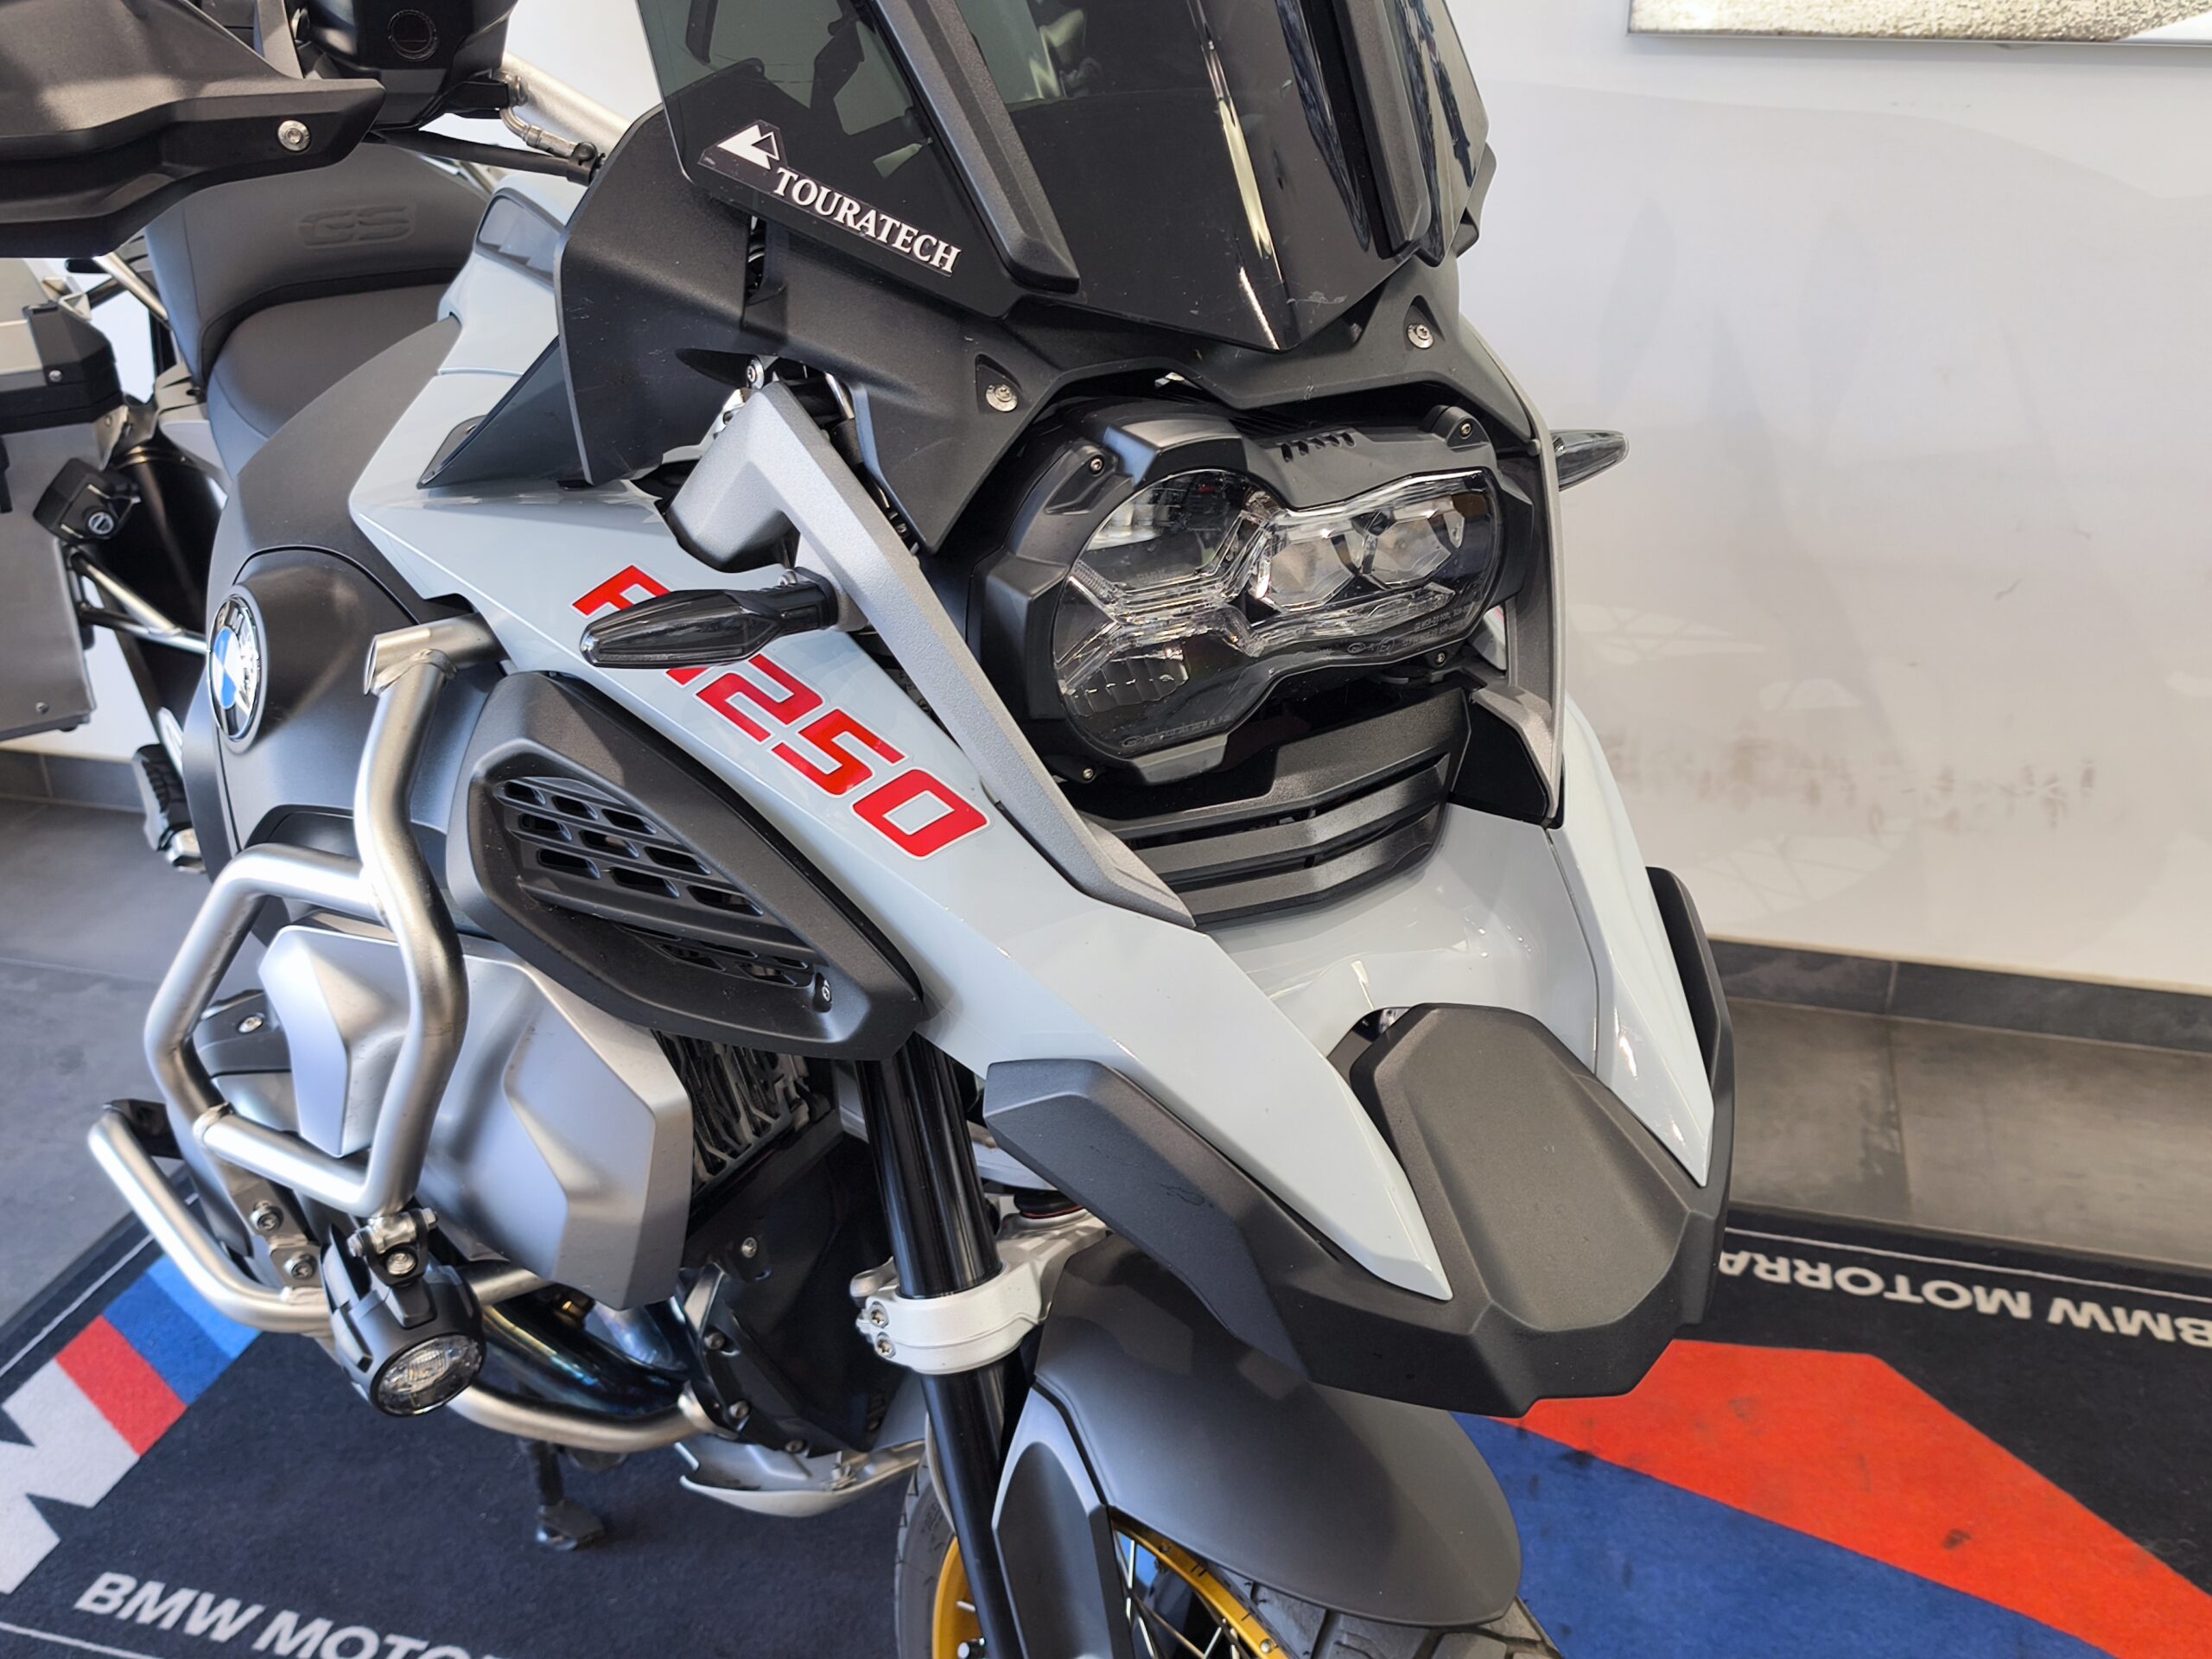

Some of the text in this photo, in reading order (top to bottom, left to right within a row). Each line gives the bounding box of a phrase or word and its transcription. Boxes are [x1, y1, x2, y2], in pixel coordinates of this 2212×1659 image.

[773, 167, 961, 273] TOURATECH
[2047, 1298, 2212, 1347] BMW
[74, 1572, 264, 1643] BMW
